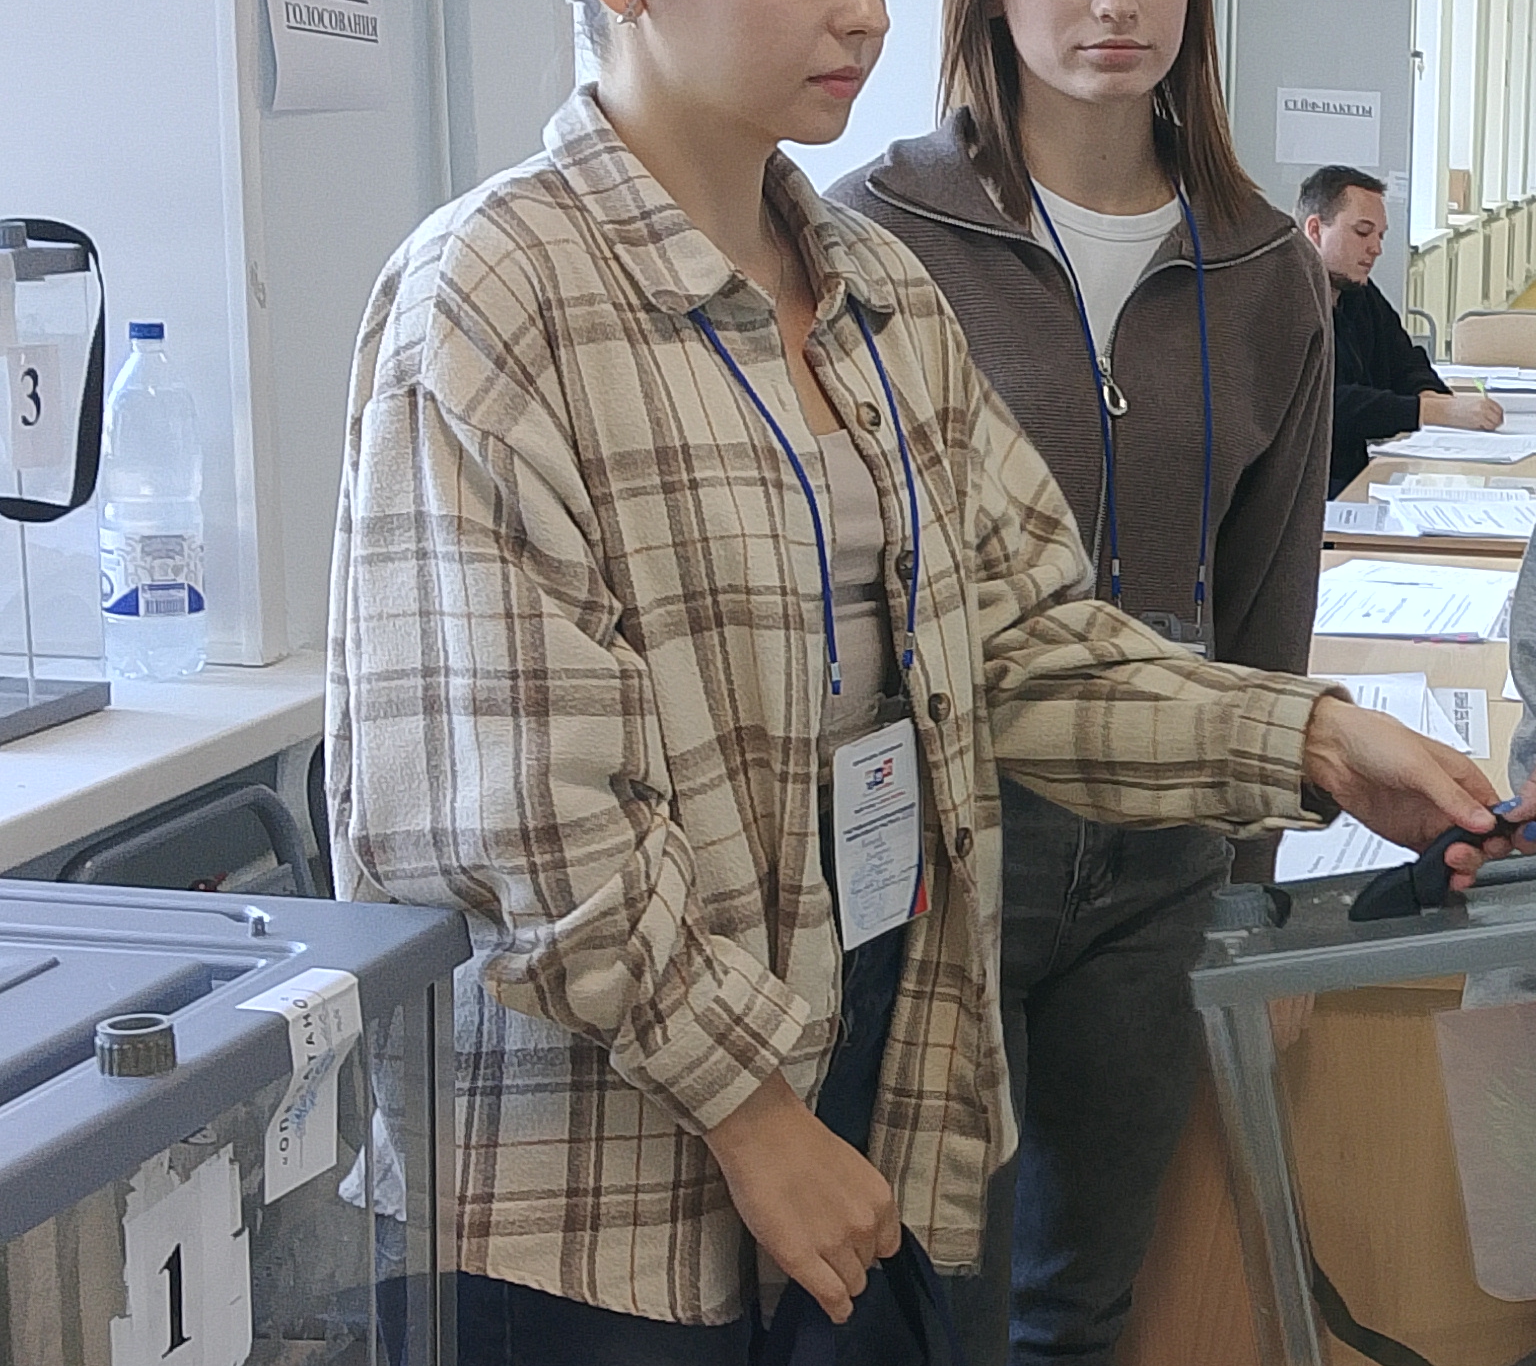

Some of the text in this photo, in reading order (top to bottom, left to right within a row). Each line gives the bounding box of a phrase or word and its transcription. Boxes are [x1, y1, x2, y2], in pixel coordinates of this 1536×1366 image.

[284, 1, 379, 38] ГОЛОСОВАНИЯ
[1284, 98, 1373, 117] СЕЙФ-ПАКЕТЫ
[20, 367, 42, 427] 3
[158, 1242, 192, 1360] 1
